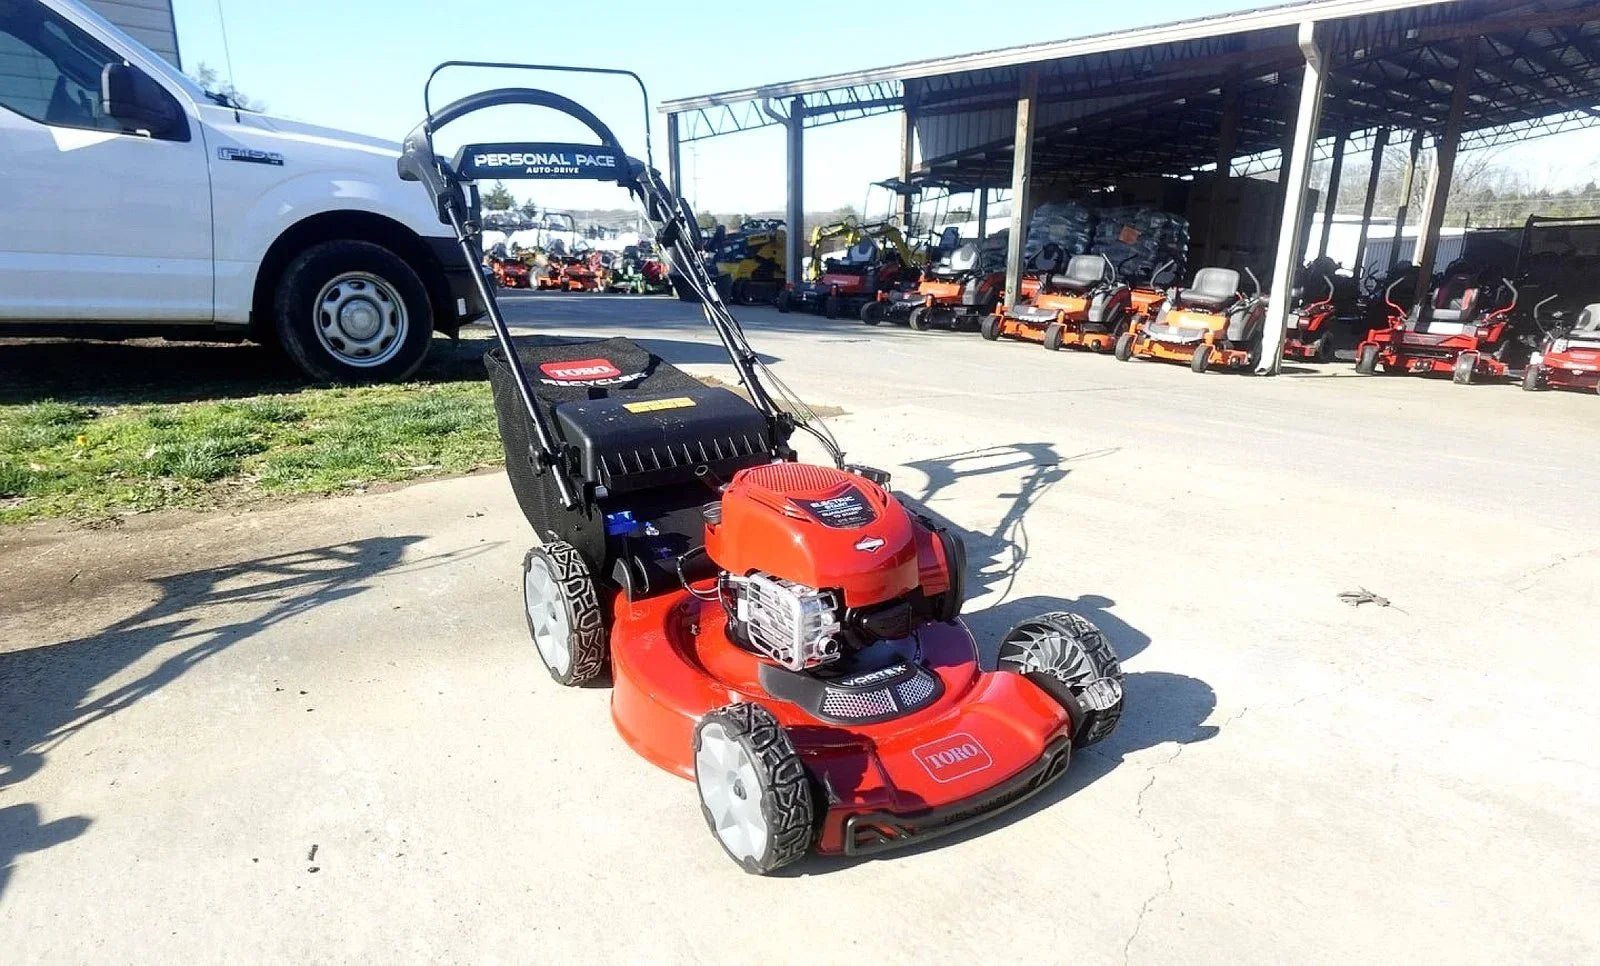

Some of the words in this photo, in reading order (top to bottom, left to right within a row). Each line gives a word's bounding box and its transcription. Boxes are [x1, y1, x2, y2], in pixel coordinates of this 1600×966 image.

[474, 153, 571, 167] PERSONAL
[575, 154, 616, 168] PACE
[550, 365, 612, 378] TORO
[842, 664, 907, 686] VORTEX
[925, 742, 980, 770] TORO
